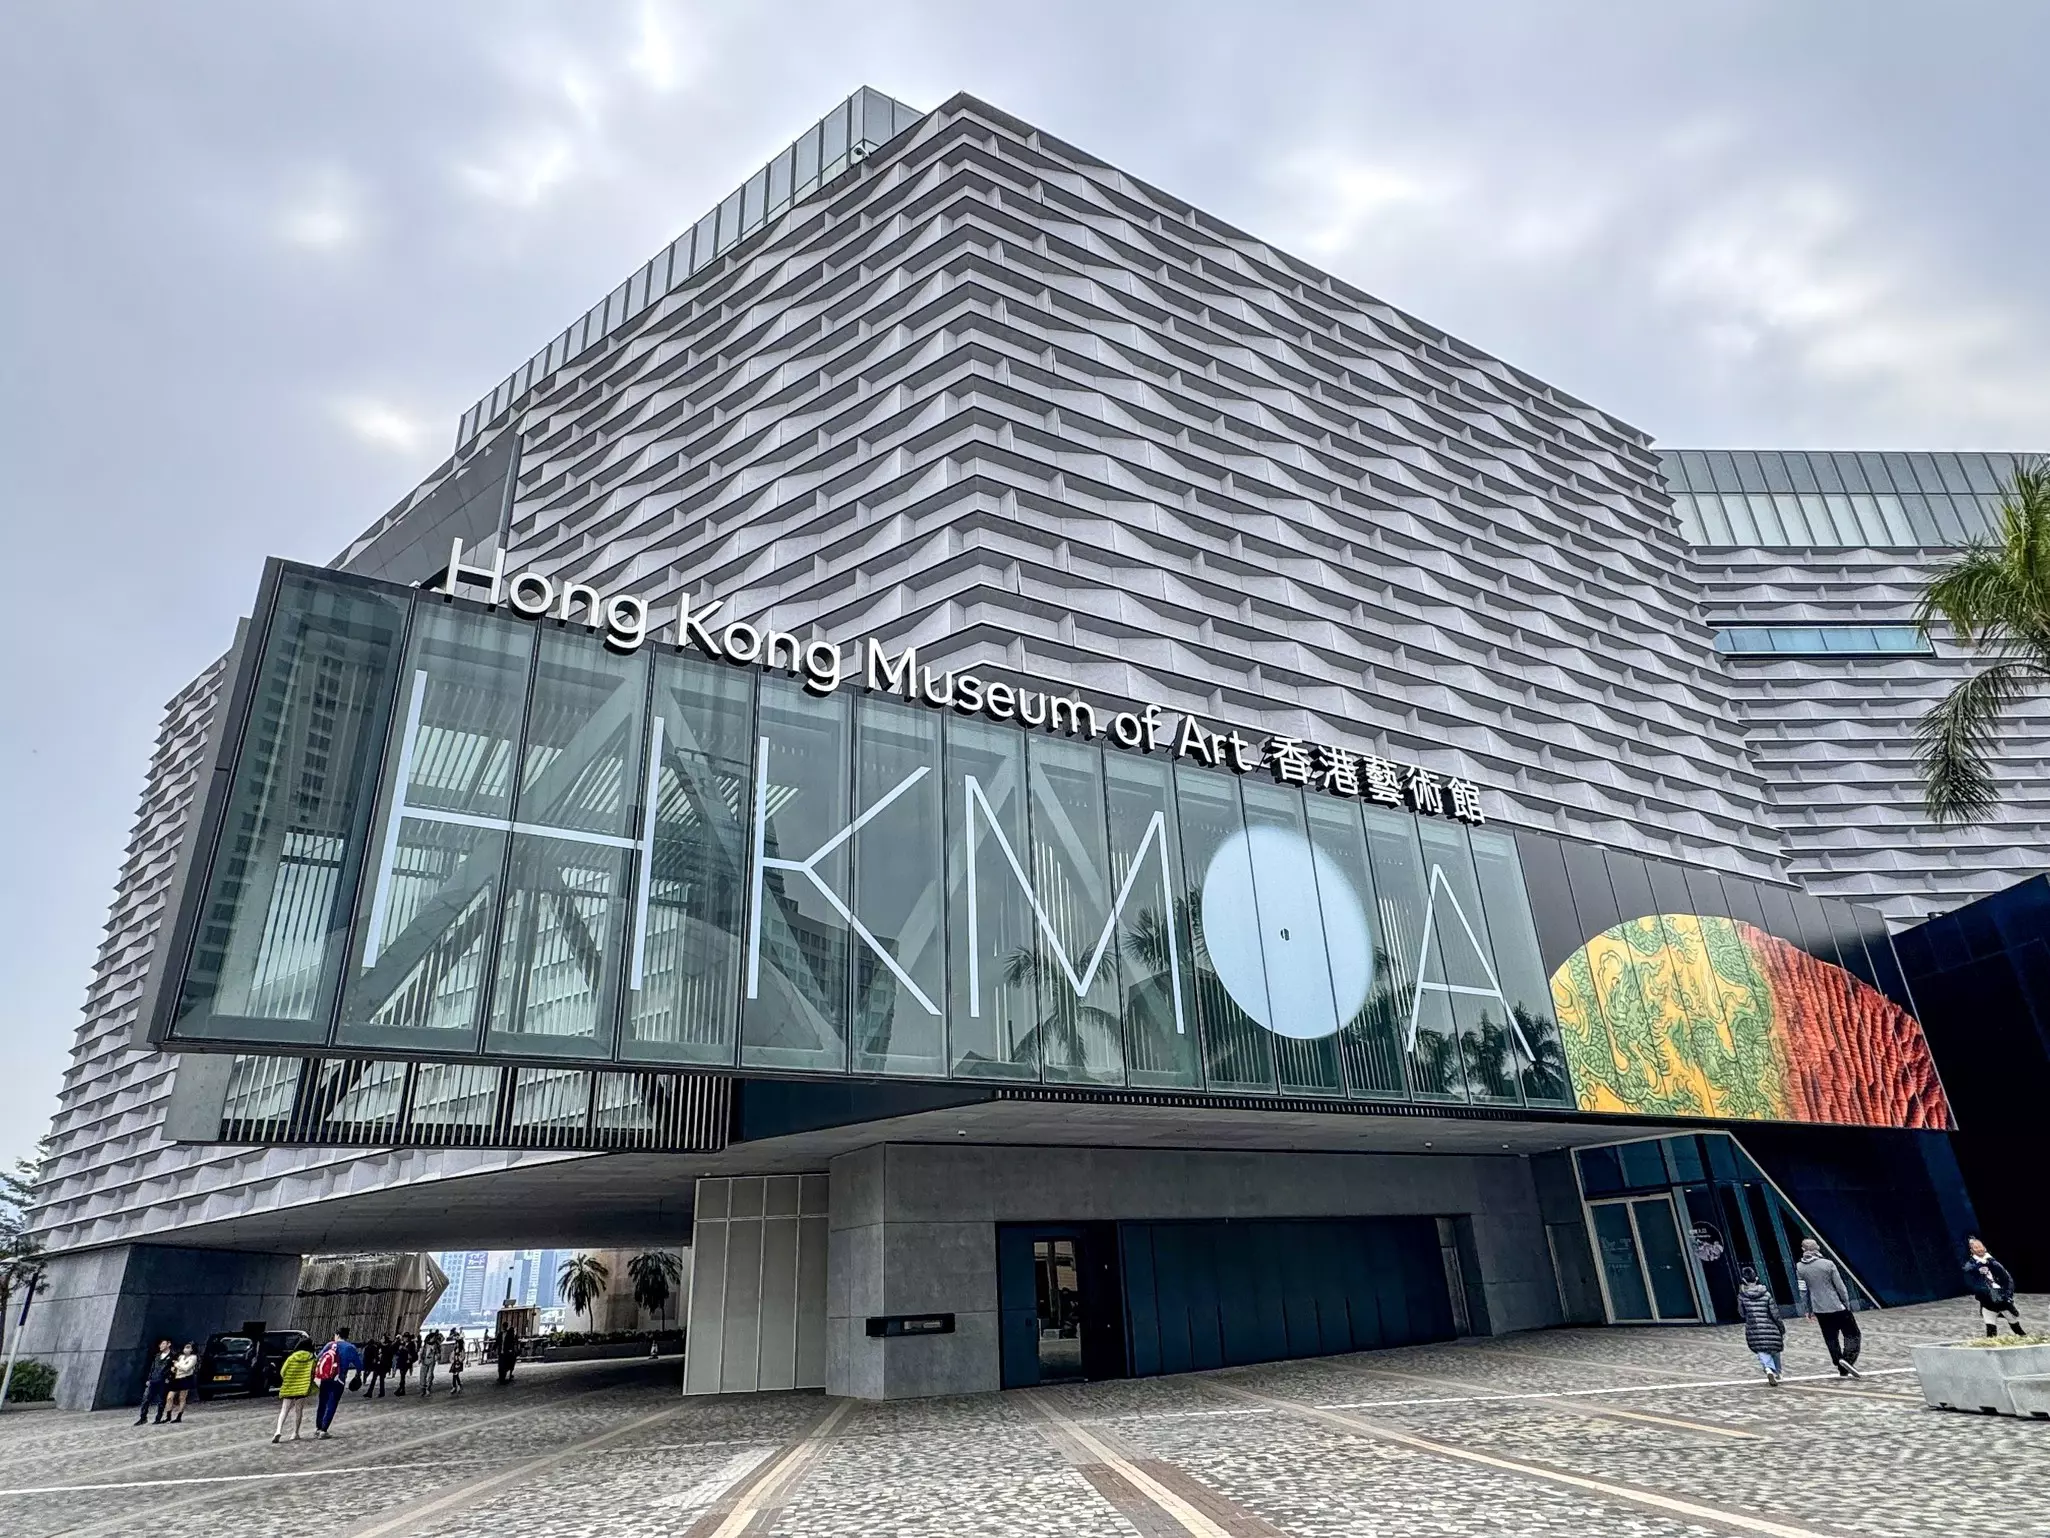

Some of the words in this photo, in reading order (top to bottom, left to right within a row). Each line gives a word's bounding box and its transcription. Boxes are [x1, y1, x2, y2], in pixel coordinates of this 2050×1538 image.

[443, 537, 649, 649] Hong
[676, 592, 843, 692] Kong
[867, 637, 1098, 737] Museum
[1114, 705, 1163, 750] of
[1180, 715, 1253, 773] Art
[360, 669, 1535, 1062] HKMOA
[1270, 736, 1487, 824] 香港藝術館
